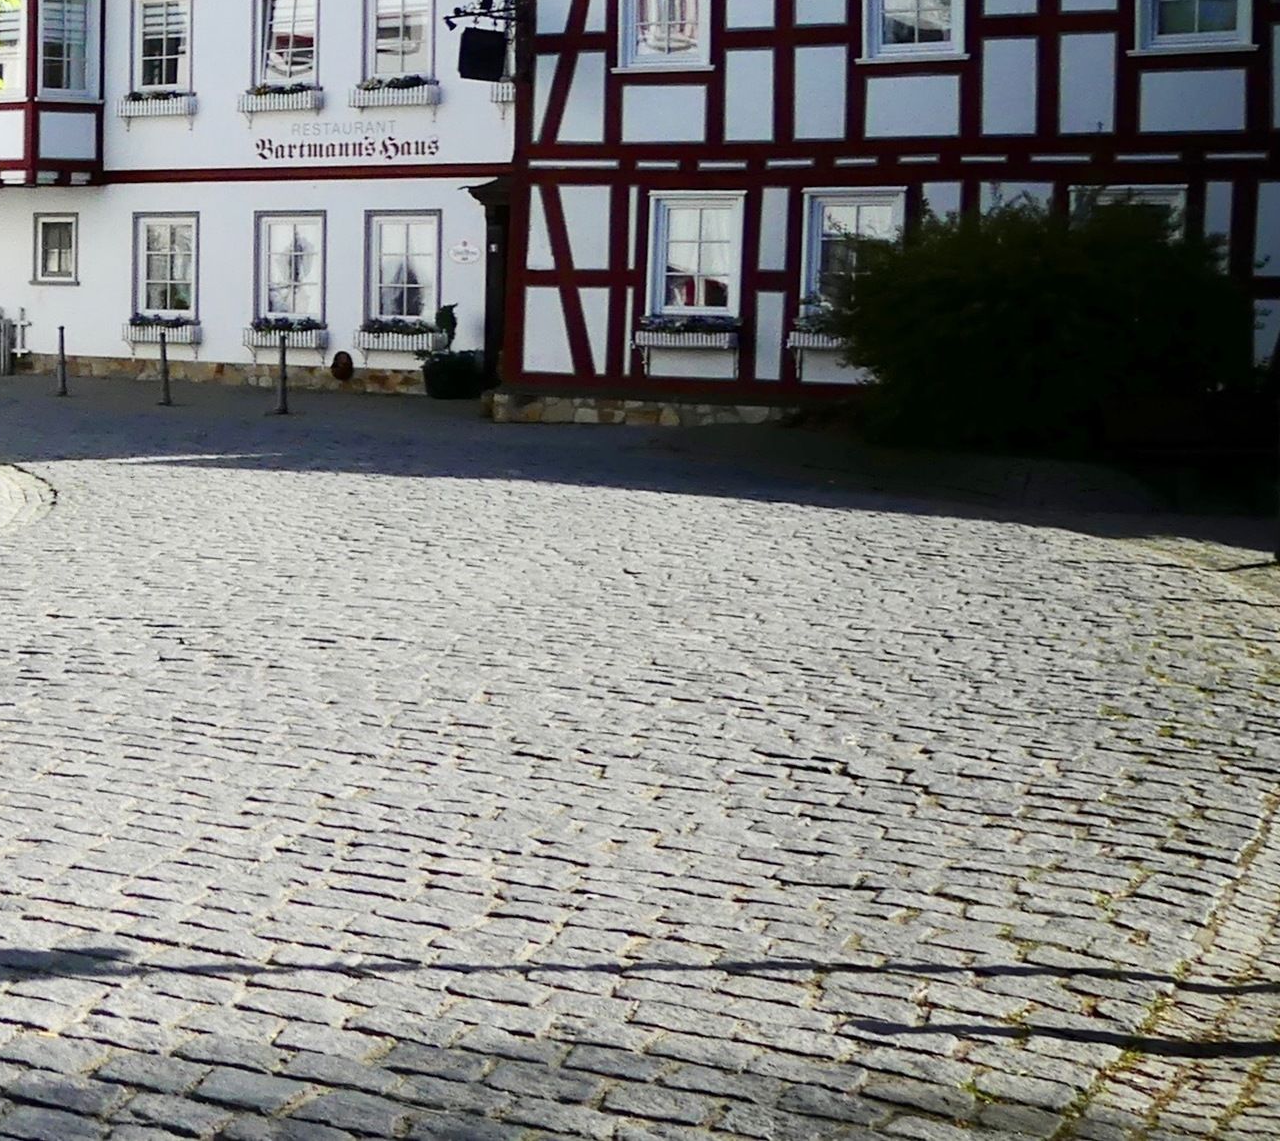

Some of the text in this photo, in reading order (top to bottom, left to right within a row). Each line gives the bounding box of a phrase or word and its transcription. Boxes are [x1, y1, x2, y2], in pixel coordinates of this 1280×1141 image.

[291, 120, 396, 136] RESTAURANT
[255, 135, 440, 160] Bartmann's Haus
